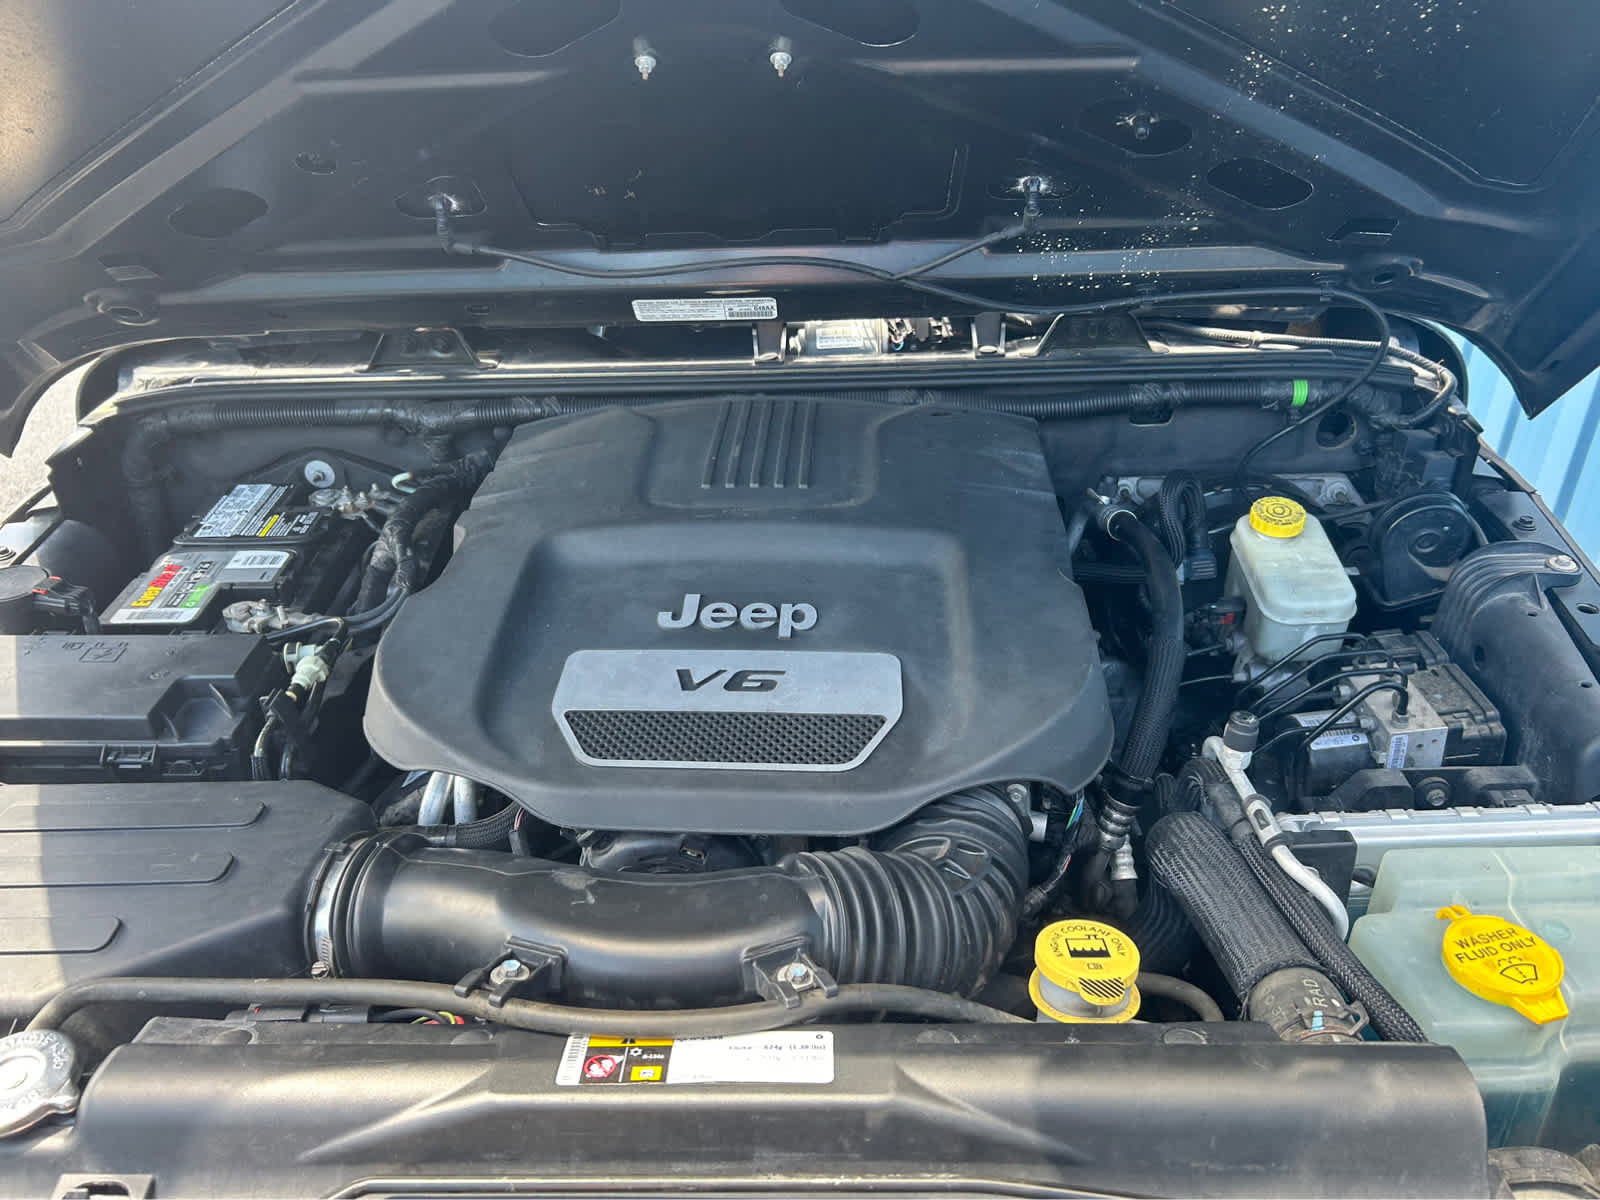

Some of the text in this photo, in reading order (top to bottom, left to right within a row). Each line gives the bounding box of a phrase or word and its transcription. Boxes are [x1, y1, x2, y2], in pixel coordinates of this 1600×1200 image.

[656, 593, 818, 640] Jeep
[675, 668, 786, 692] V6
[1061, 925, 1111, 937] COOLANT
[1111, 937, 1127, 957] ONLY
[1454, 927, 1518, 949] WASHER
[1455, 936, 1537, 963] FLUID ONLY
[1303, 978, 1329, 1008] RAD
